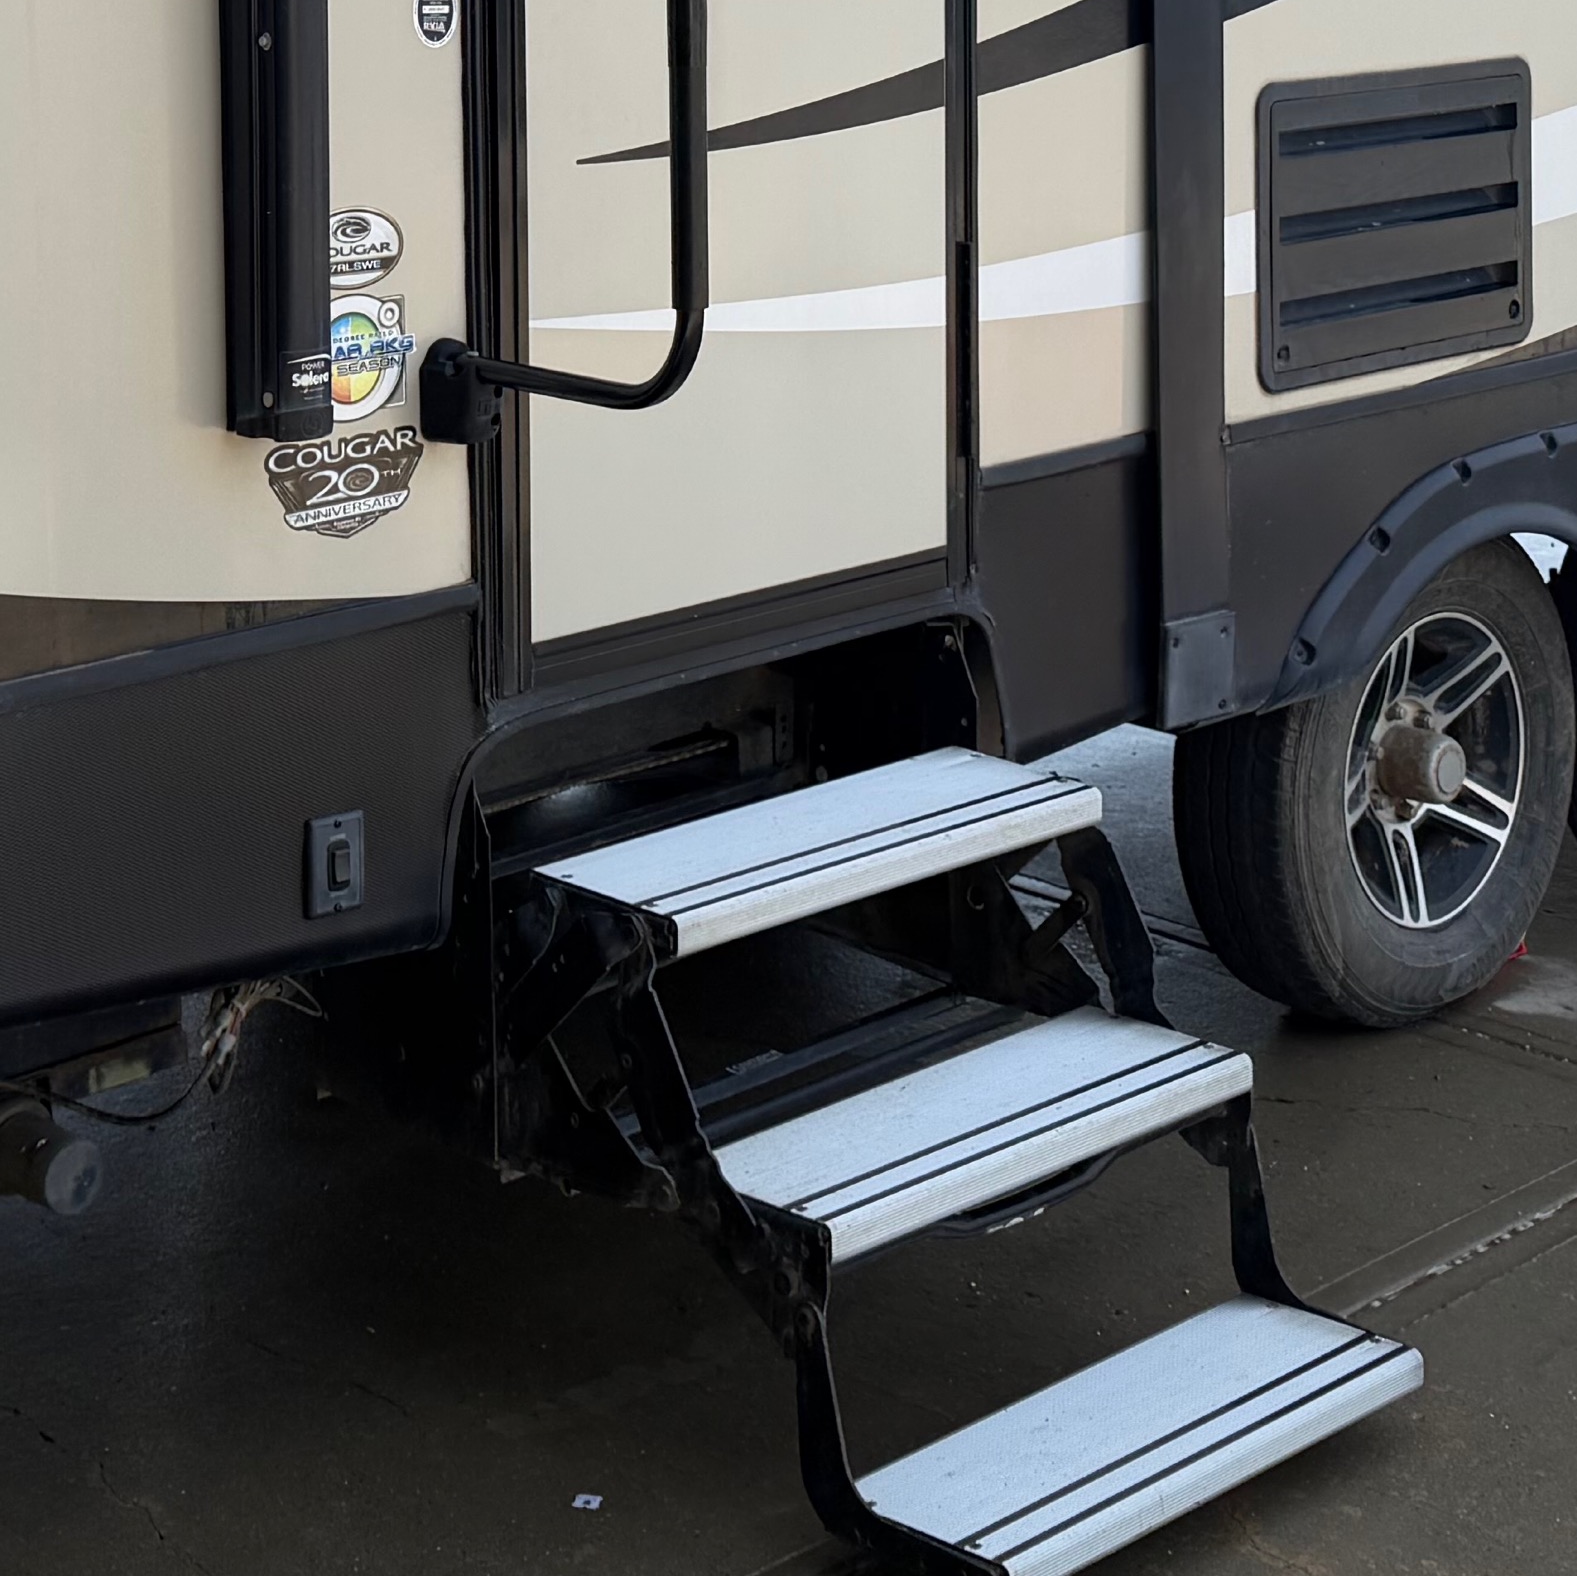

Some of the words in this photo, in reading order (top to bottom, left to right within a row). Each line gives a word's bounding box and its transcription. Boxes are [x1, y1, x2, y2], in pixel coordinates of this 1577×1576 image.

[329, 241, 394, 258] OUGAR
[330, 260, 381, 273] 7RLSWE
[336, 355, 402, 377] SEASON
[268, 429, 418, 473] COUGAR
[291, 492, 403, 525] ANNIVERSARY
